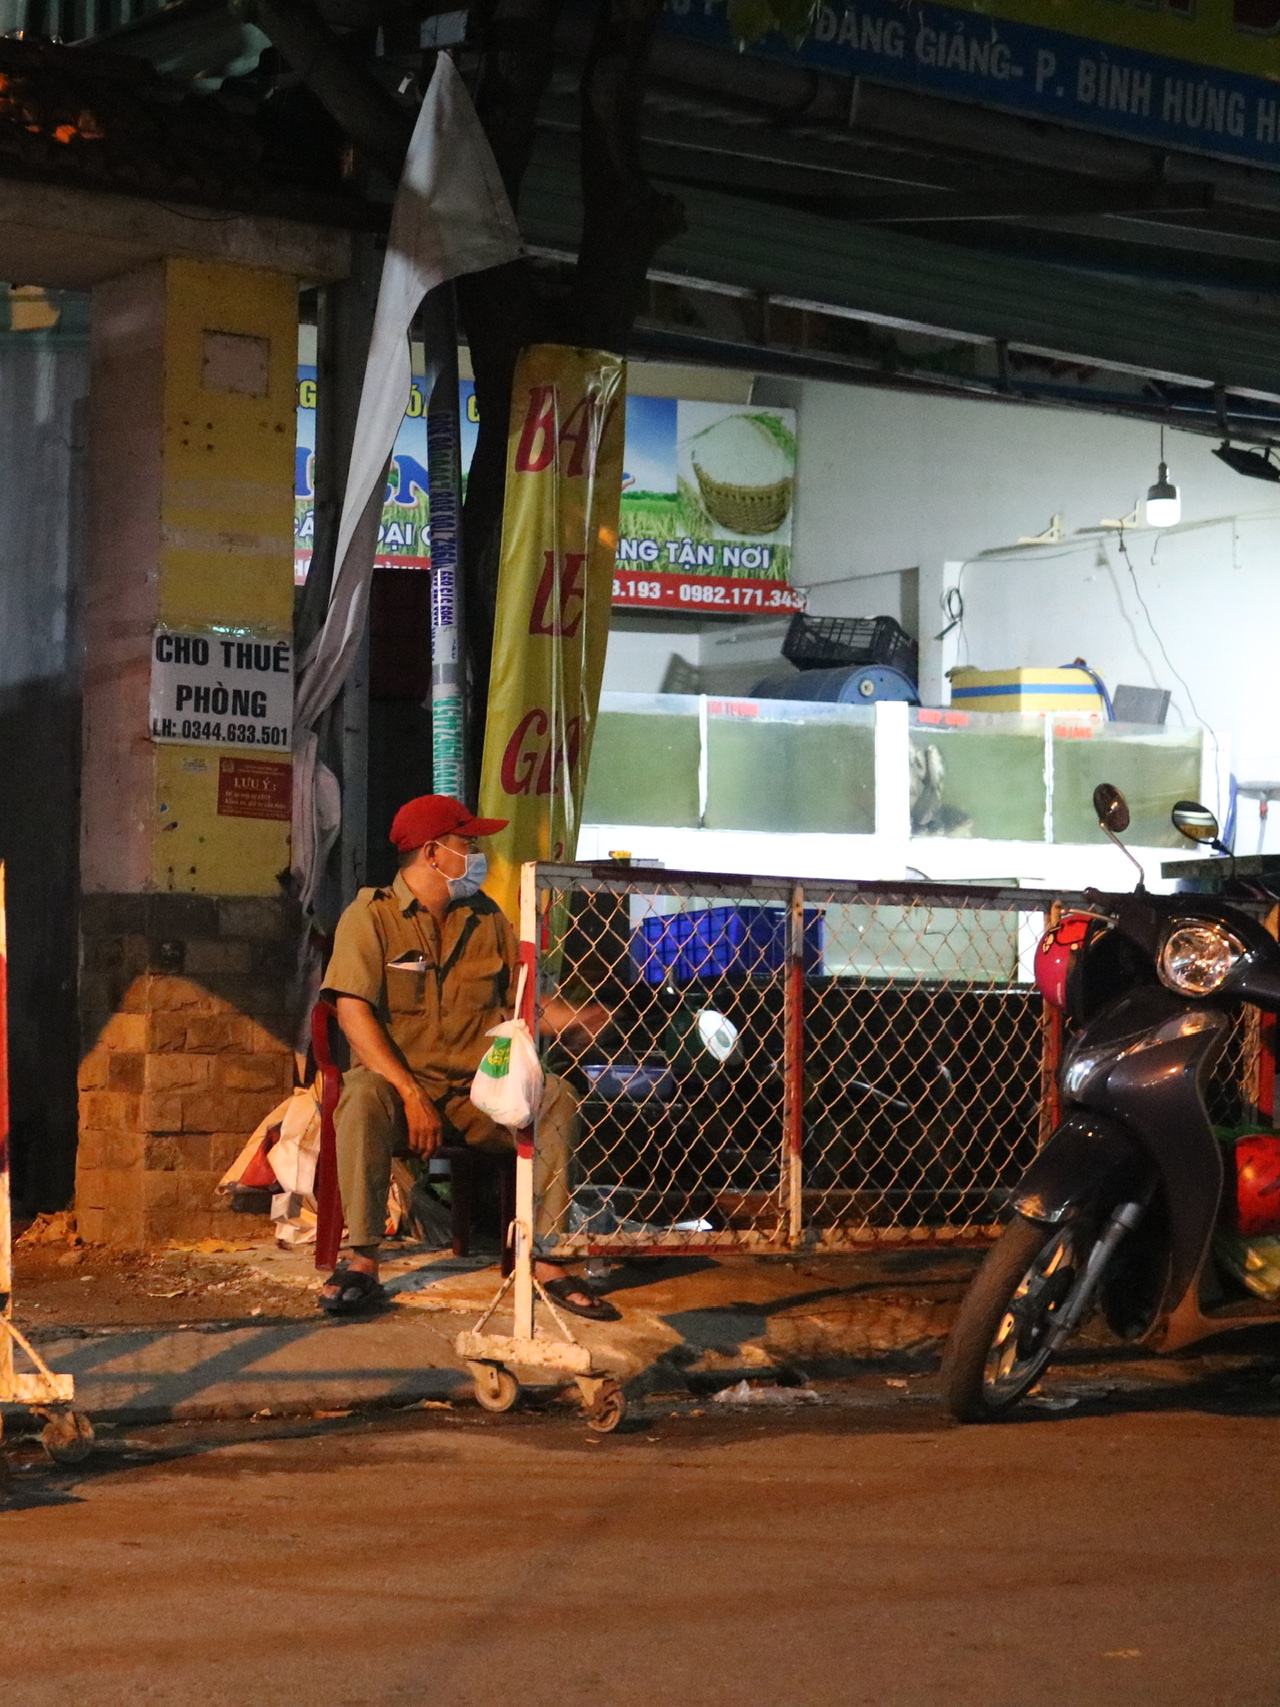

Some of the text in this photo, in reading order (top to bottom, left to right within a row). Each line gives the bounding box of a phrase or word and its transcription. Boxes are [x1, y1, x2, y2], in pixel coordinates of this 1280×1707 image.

[1077, 50, 1153, 117] BÌNH
[667, 538, 770, 570] TẬN NƠI
[155, 634, 290, 673] CHO THUÊ
[176, 681, 267, 718] PHÒNG
[152, 717, 288, 746] LH: 0344.633.501
[234, 777, 260, 789] LƯU
